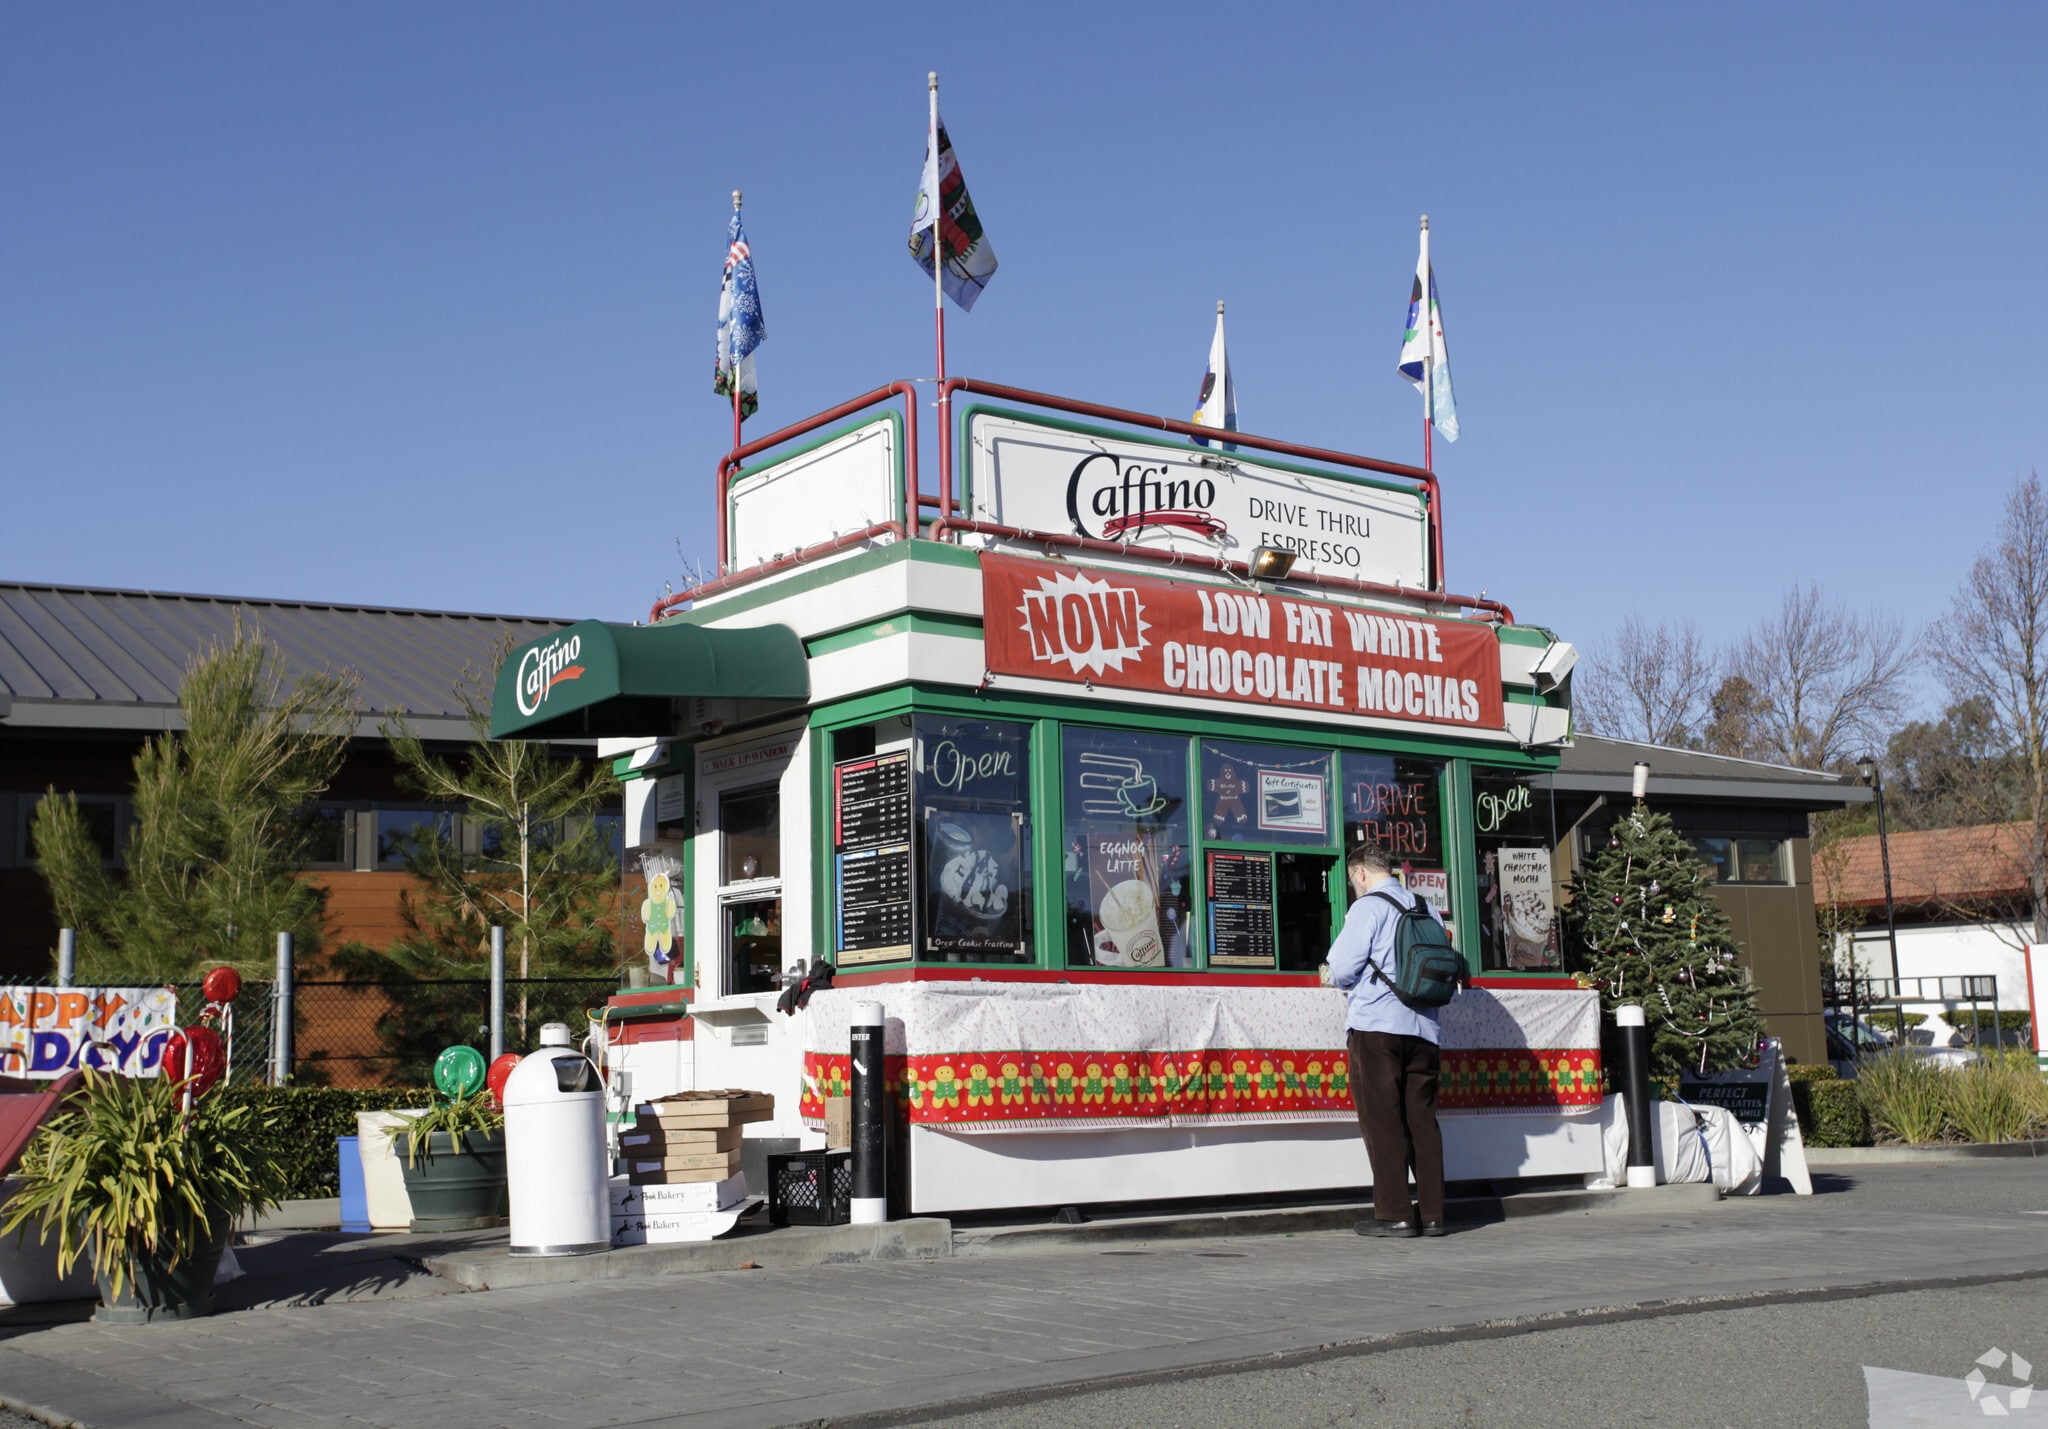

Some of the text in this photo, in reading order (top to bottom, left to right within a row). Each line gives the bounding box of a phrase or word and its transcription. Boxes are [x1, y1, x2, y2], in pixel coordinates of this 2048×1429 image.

[1066, 453, 1216, 541] Caffino
[1249, 497, 1370, 538] DRIVE THRU
[1261, 531, 1361, 567] ESPRESSO
[1025, 586, 1142, 660] NOW
[1198, 589, 1442, 664] LOW FAT WHITE
[516, 634, 582, 717] Caffino
[1162, 641, 1480, 723] CHOCOLATE MOCHAS
[712, 759, 735, 769] WALK
[933, 740, 1016, 791] Open
[1265, 777, 1318, 791] Gift Certificates
[1357, 782, 1428, 816] DRIVE
[1476, 784, 1533, 832] Open
[1362, 819, 1428, 854] THRU
[1100, 840, 1146, 858] EGGNOG
[1512, 852, 1537, 861] WHITE
[1106, 859, 1141, 873] LATTE
[1503, 863, 1548, 873] CHRISTMAS
[1409, 874, 1446, 890] OPEN
[1513, 874, 1540, 884] MOCHA
[0, 992, 128, 1030] APPY
[1699, 1087, 1749, 1098] PERFECT
[1731, 1099, 1762, 1107] LATTES
[1739, 1109, 1761, 1117] SMILE
[657, 1190, 685, 1202] Bakery
[652, 1220, 681, 1232] Bakery
